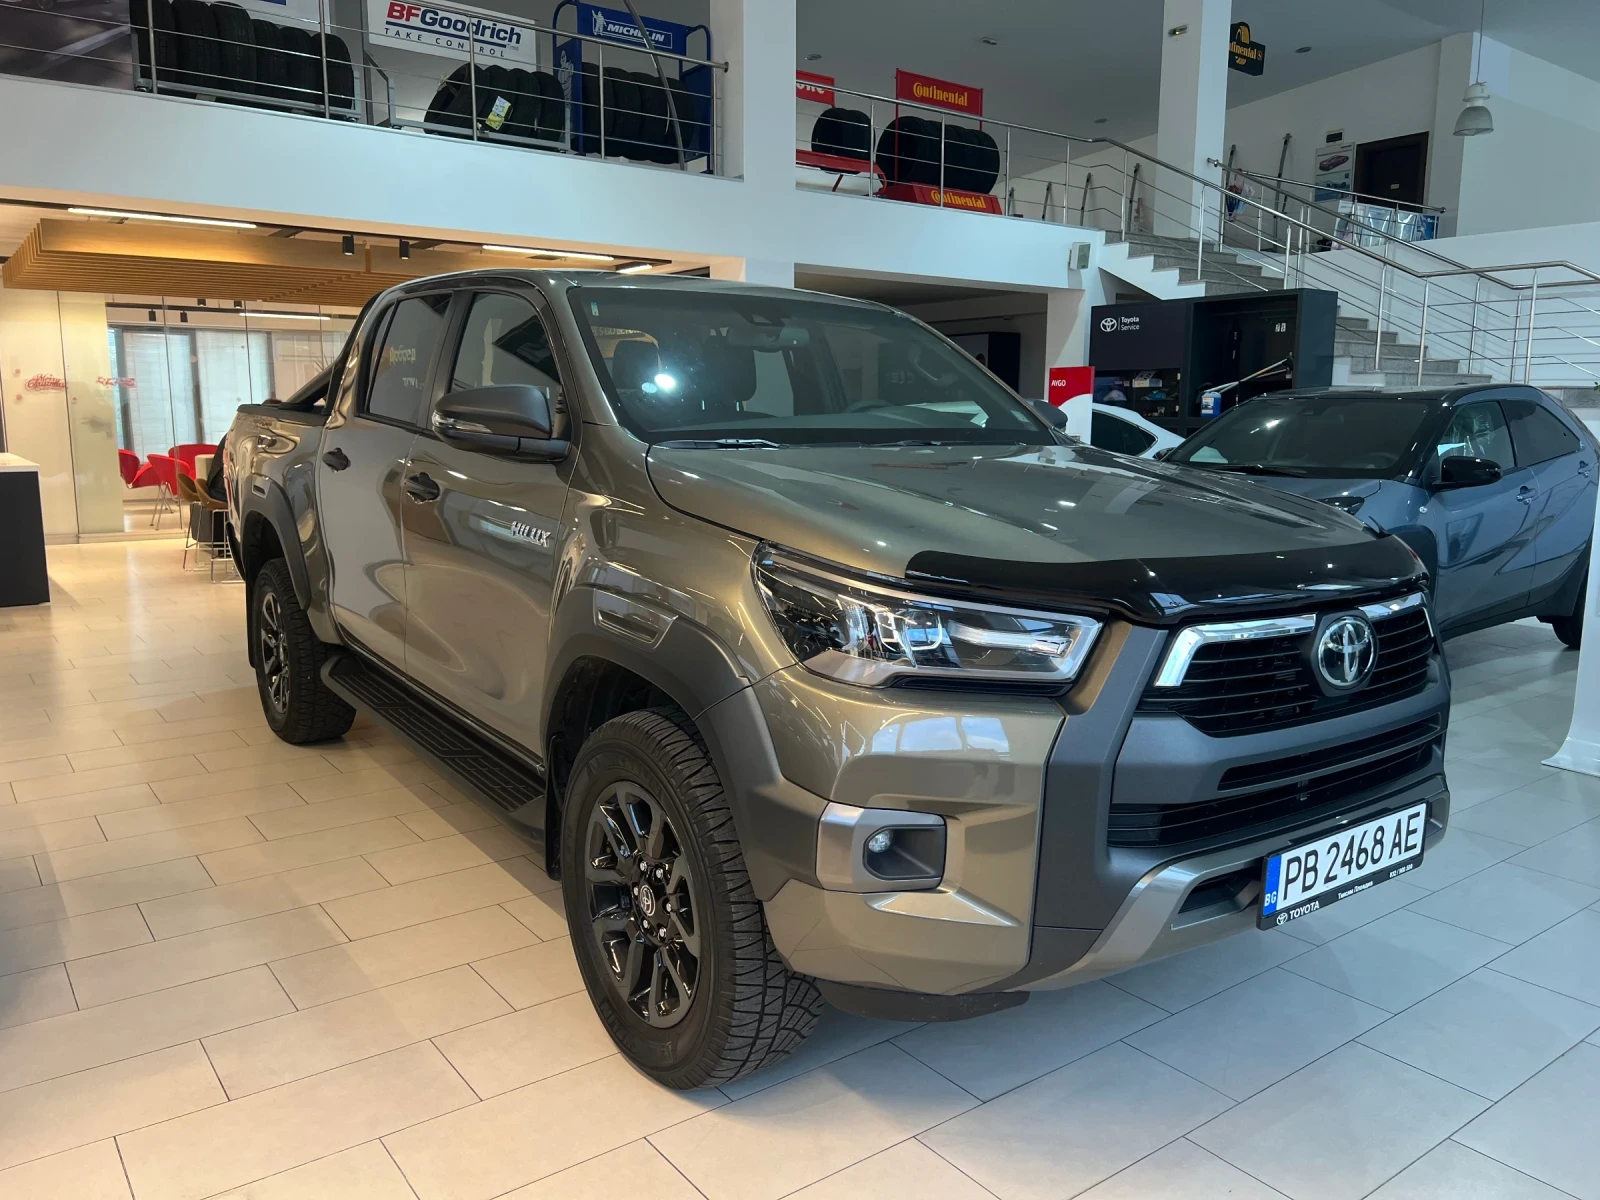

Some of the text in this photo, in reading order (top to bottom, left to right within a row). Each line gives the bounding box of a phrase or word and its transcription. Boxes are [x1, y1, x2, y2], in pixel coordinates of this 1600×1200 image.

[386, 1, 522, 44] BFGoodrich
[384, 27, 505, 57] TAKE CONROL
[1230, 41, 1257, 60] tinental
[912, 81, 968, 107] Continental
[1120, 316, 1140, 325] Toyota
[1051, 379, 1067, 387] AYGO
[510, 520, 552, 548] HILUX
[1283, 811, 1421, 901] PB 2468 AE
[1264, 890, 1277, 907] BG
[1289, 900, 1320, 920] TOYOTA
